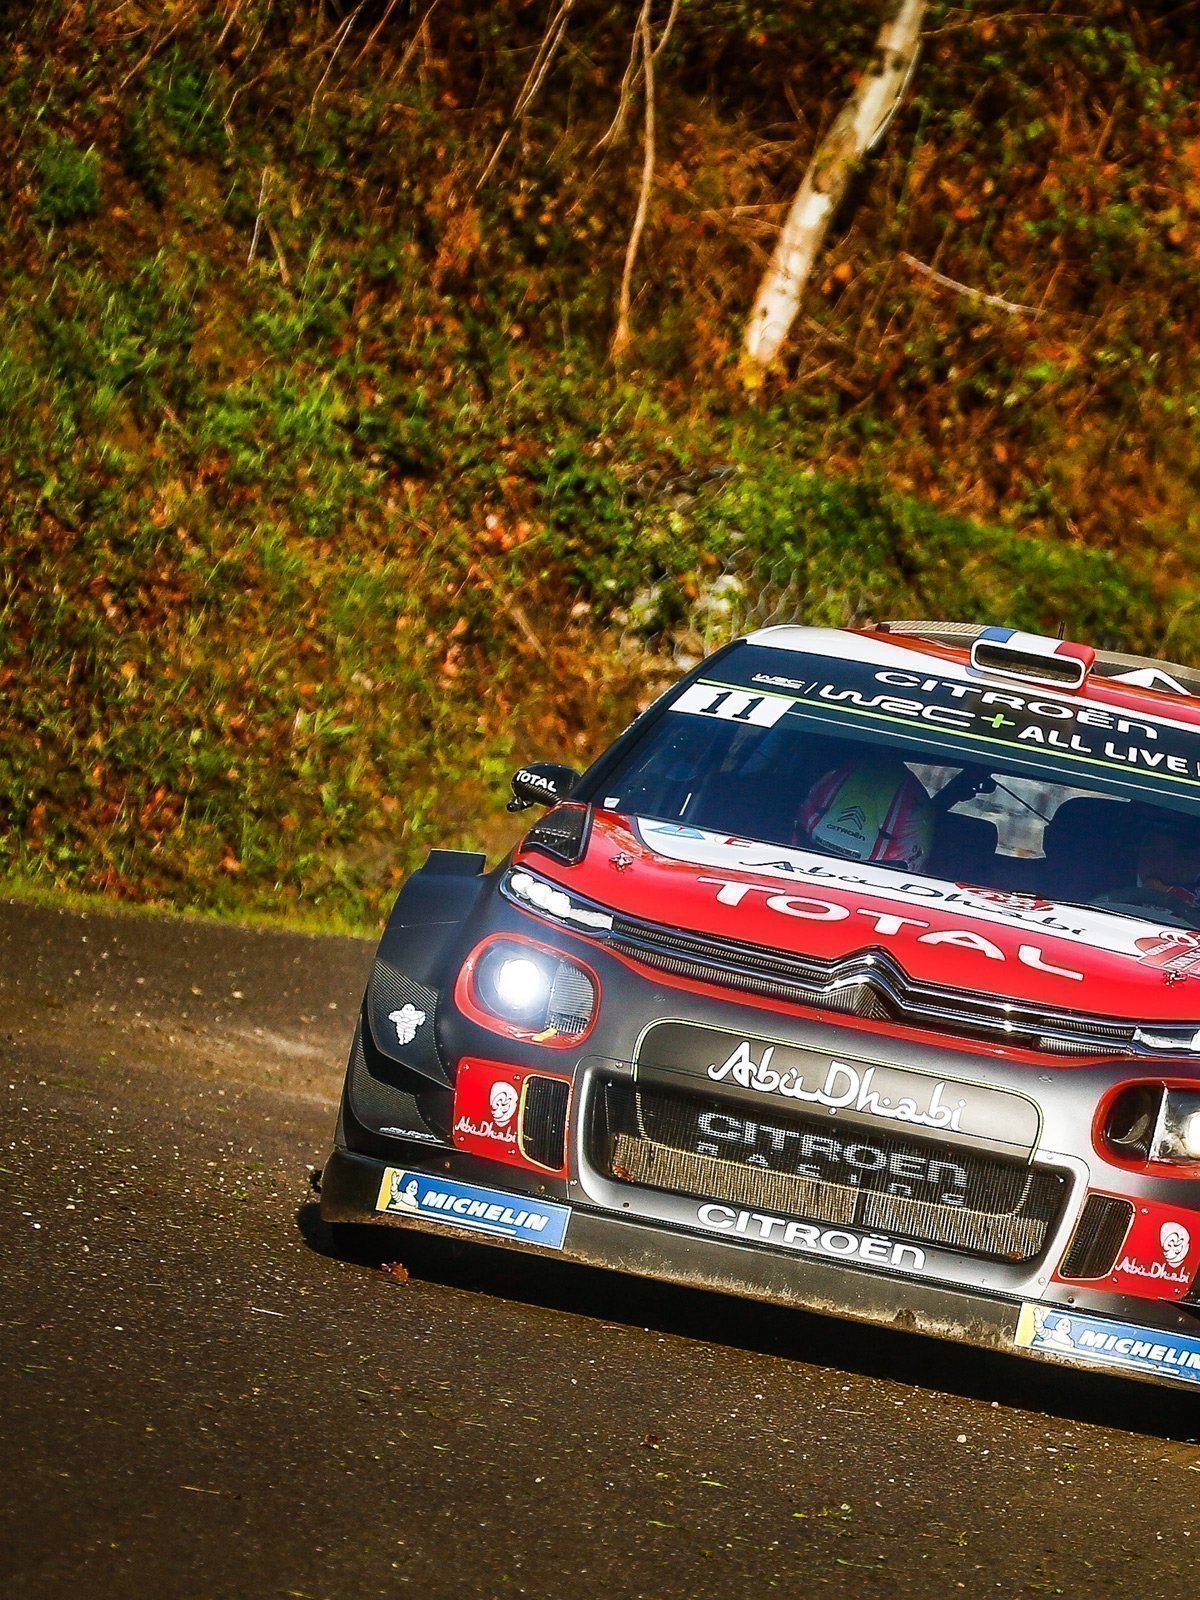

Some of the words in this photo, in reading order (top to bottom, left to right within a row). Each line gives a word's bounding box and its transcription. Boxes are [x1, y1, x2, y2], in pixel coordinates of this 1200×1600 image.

[699, 691, 765, 720] 11
[1017, 724, 1092, 753] ALL
[1103, 741, 1189, 774] LIVE
[516, 769, 557, 793] TOTAL
[696, 876, 1085, 982] TOTAL
[421, 1190, 550, 1232] MICHELIN
[696, 1202, 927, 1270] CITROËN
